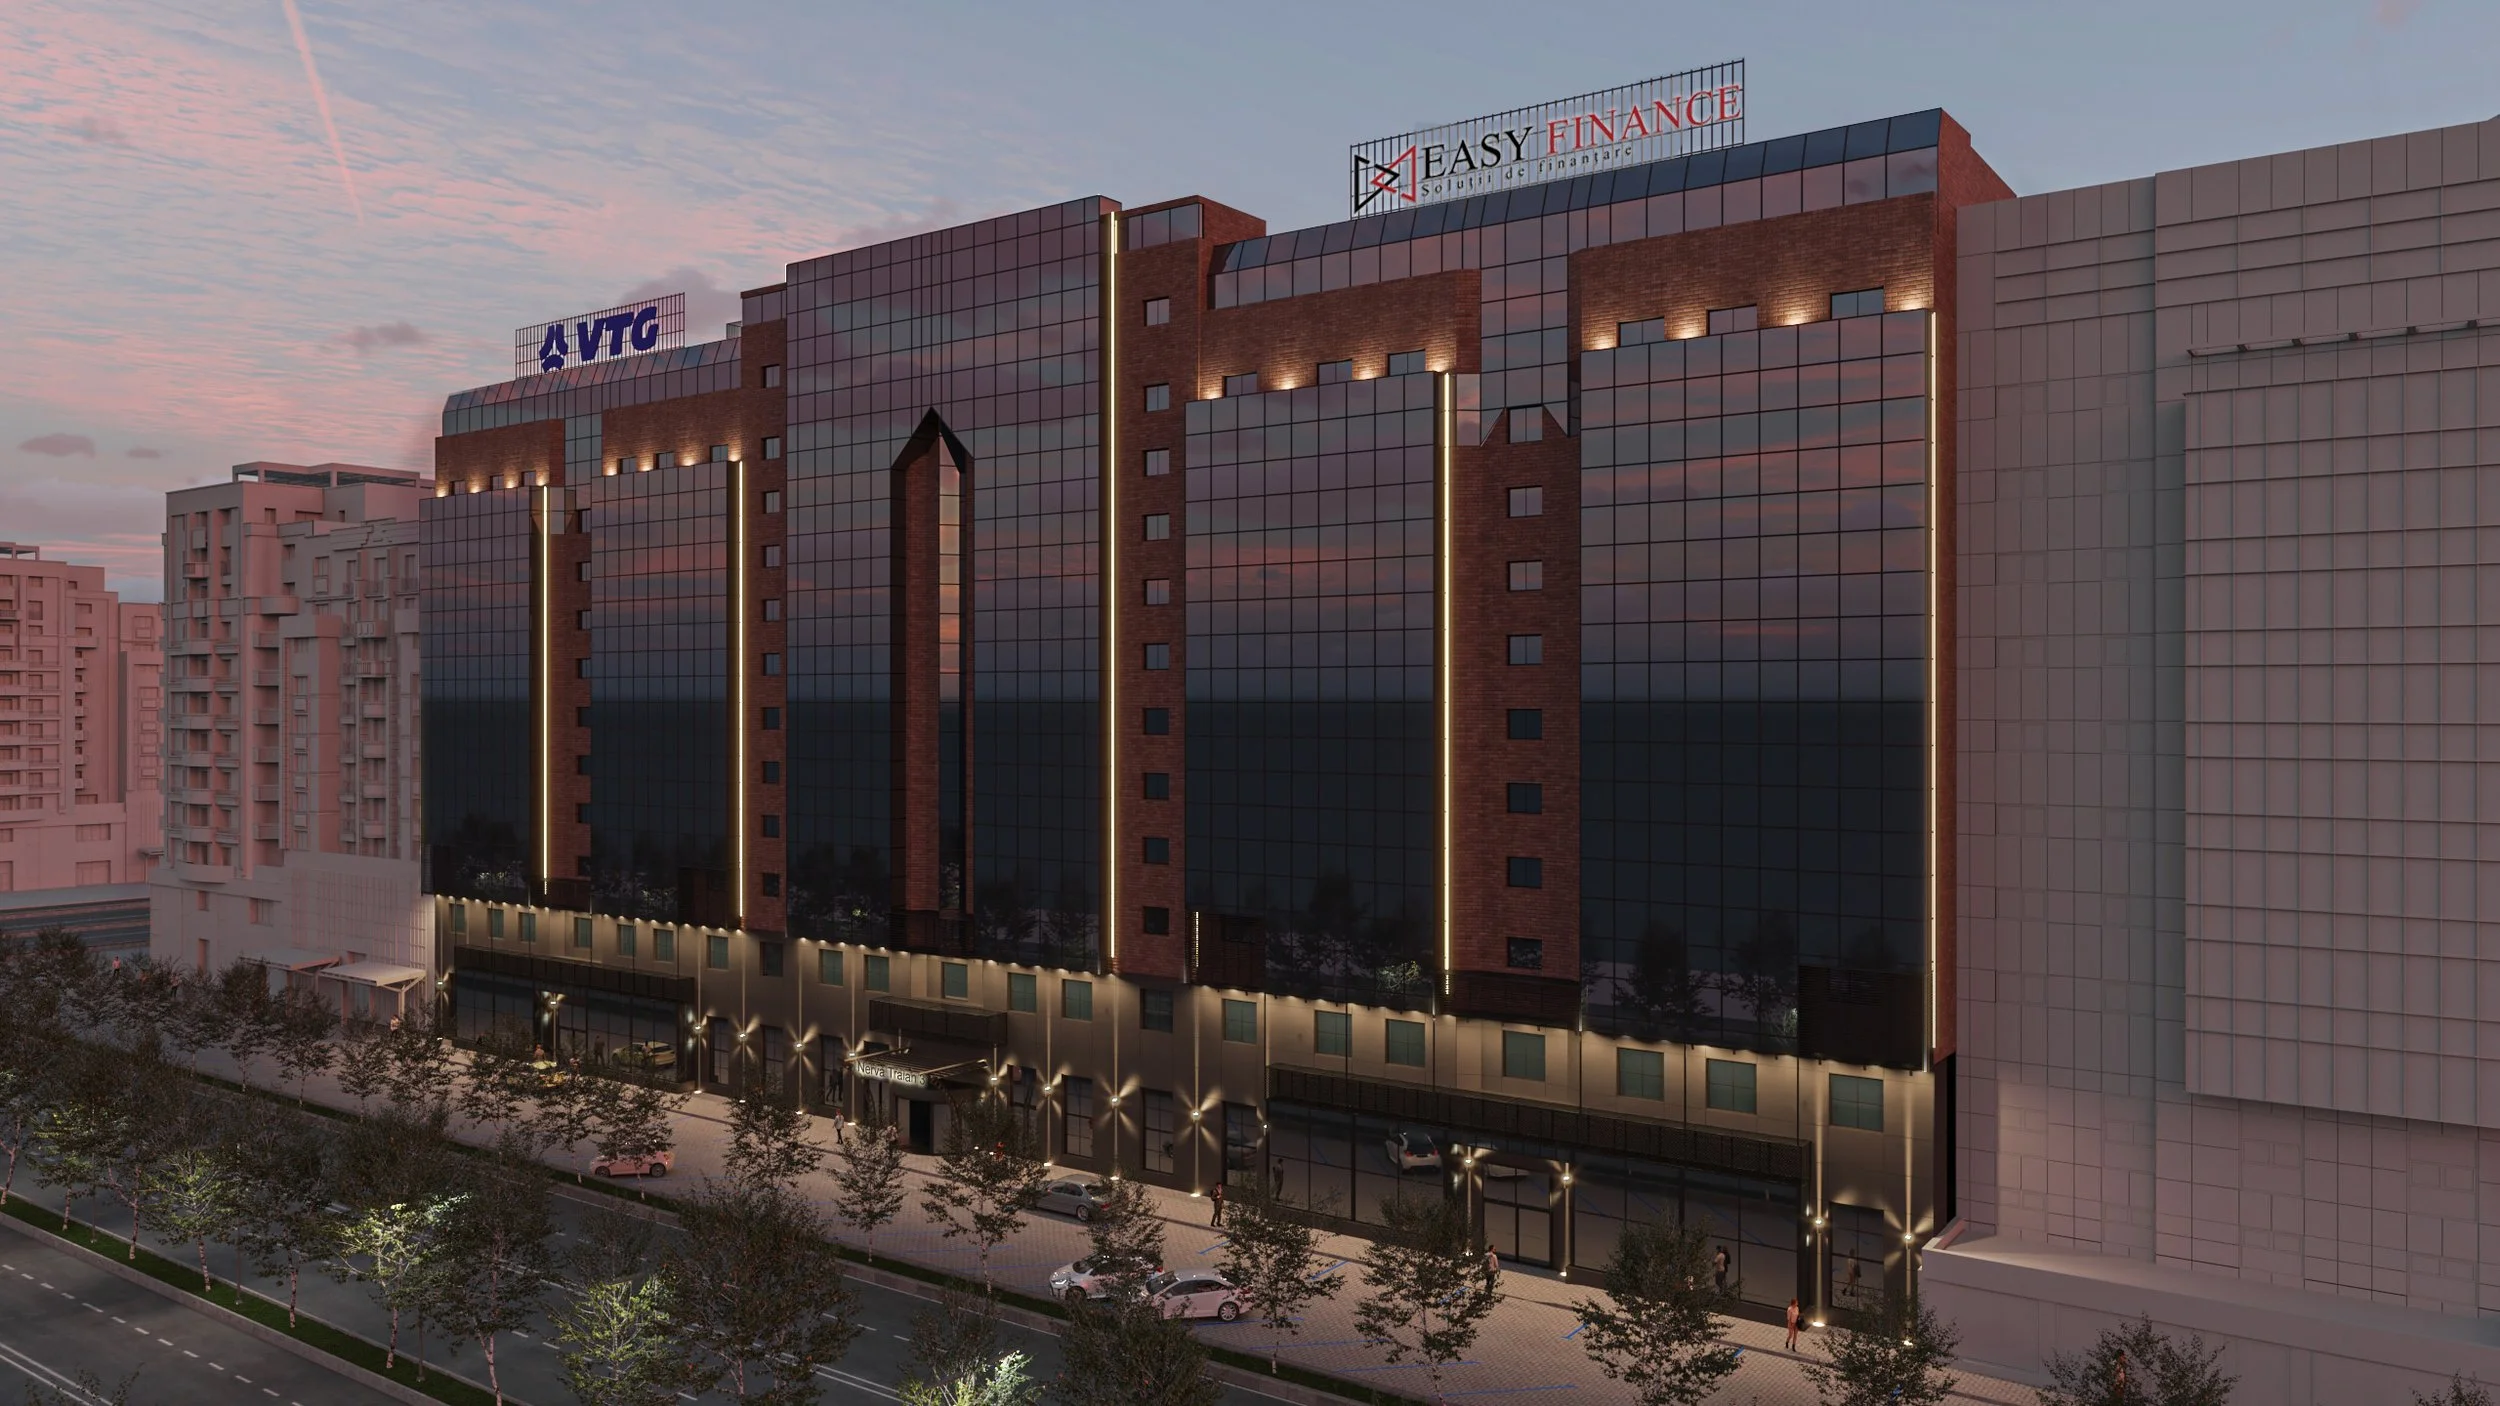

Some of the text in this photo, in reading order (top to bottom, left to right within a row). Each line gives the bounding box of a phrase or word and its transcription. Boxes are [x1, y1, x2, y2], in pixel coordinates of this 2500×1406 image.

[1422, 85, 1742, 181] EASY FINANCE
[1505, 166, 1525, 180] de
[577, 306, 659, 362] VTG
[857, 1060, 926, 1086] Nerva Traian 3
